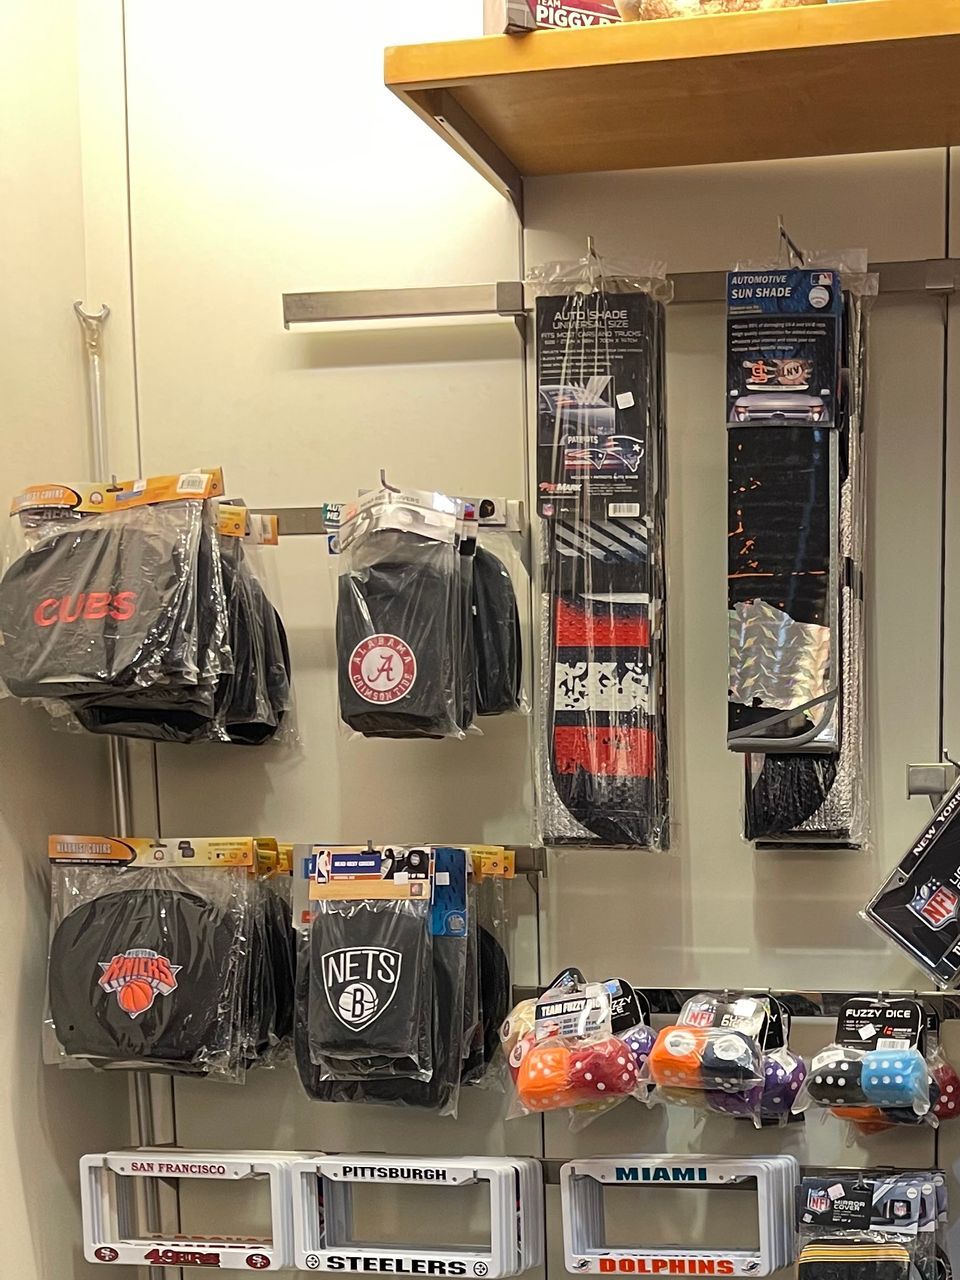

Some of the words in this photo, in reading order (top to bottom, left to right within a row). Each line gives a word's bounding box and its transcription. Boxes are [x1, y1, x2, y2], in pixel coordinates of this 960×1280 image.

[536, 5, 594, 28] PIGGY
[731, 275, 788, 285] AUTOMOTIVE
[731, 288, 753, 299] SUN
[755, 287, 793, 298] SHADE
[554, 310, 585, 320] AUTO
[588, 310, 628, 320] SHADE
[553, 320, 605, 330] UNIVERSAL
[608, 319, 629, 328] SIZE
[568, 435, 599, 444] PATRIOTS
[33, 591, 137, 627] CUBS
[355, 634, 412, 665] ALABAMA
[367, 654, 395, 682] A
[352, 673, 393, 702] CRIMSON
[393, 673, 414, 697] TIDE
[912, 826, 936, 857] NEW
[920, 885, 958, 925] NFL
[107, 957, 176, 986] KNICKS
[327, 950, 396, 988] NETS
[351, 988, 364, 1018] B
[541, 1005, 562, 1018] TEAM
[564, 999, 586, 1014] FUZZY
[688, 1011, 713, 1026] NFL
[845, 1008, 883, 1018] FUZZY
[885, 1008, 911, 1018] DICE
[131, 1162, 154, 1172] SAN
[158, 1163, 226, 1175] FRANCISCO
[342, 1165, 447, 1181] PITTSBURGH
[615, 1167, 707, 1181] MIAMI
[809, 1198, 830, 1212] NFL
[834, 1199, 866, 1207] MIRROR
[326, 1255, 467, 1275] STEELERS
[599, 1258, 734, 1275] DOLPHINS
